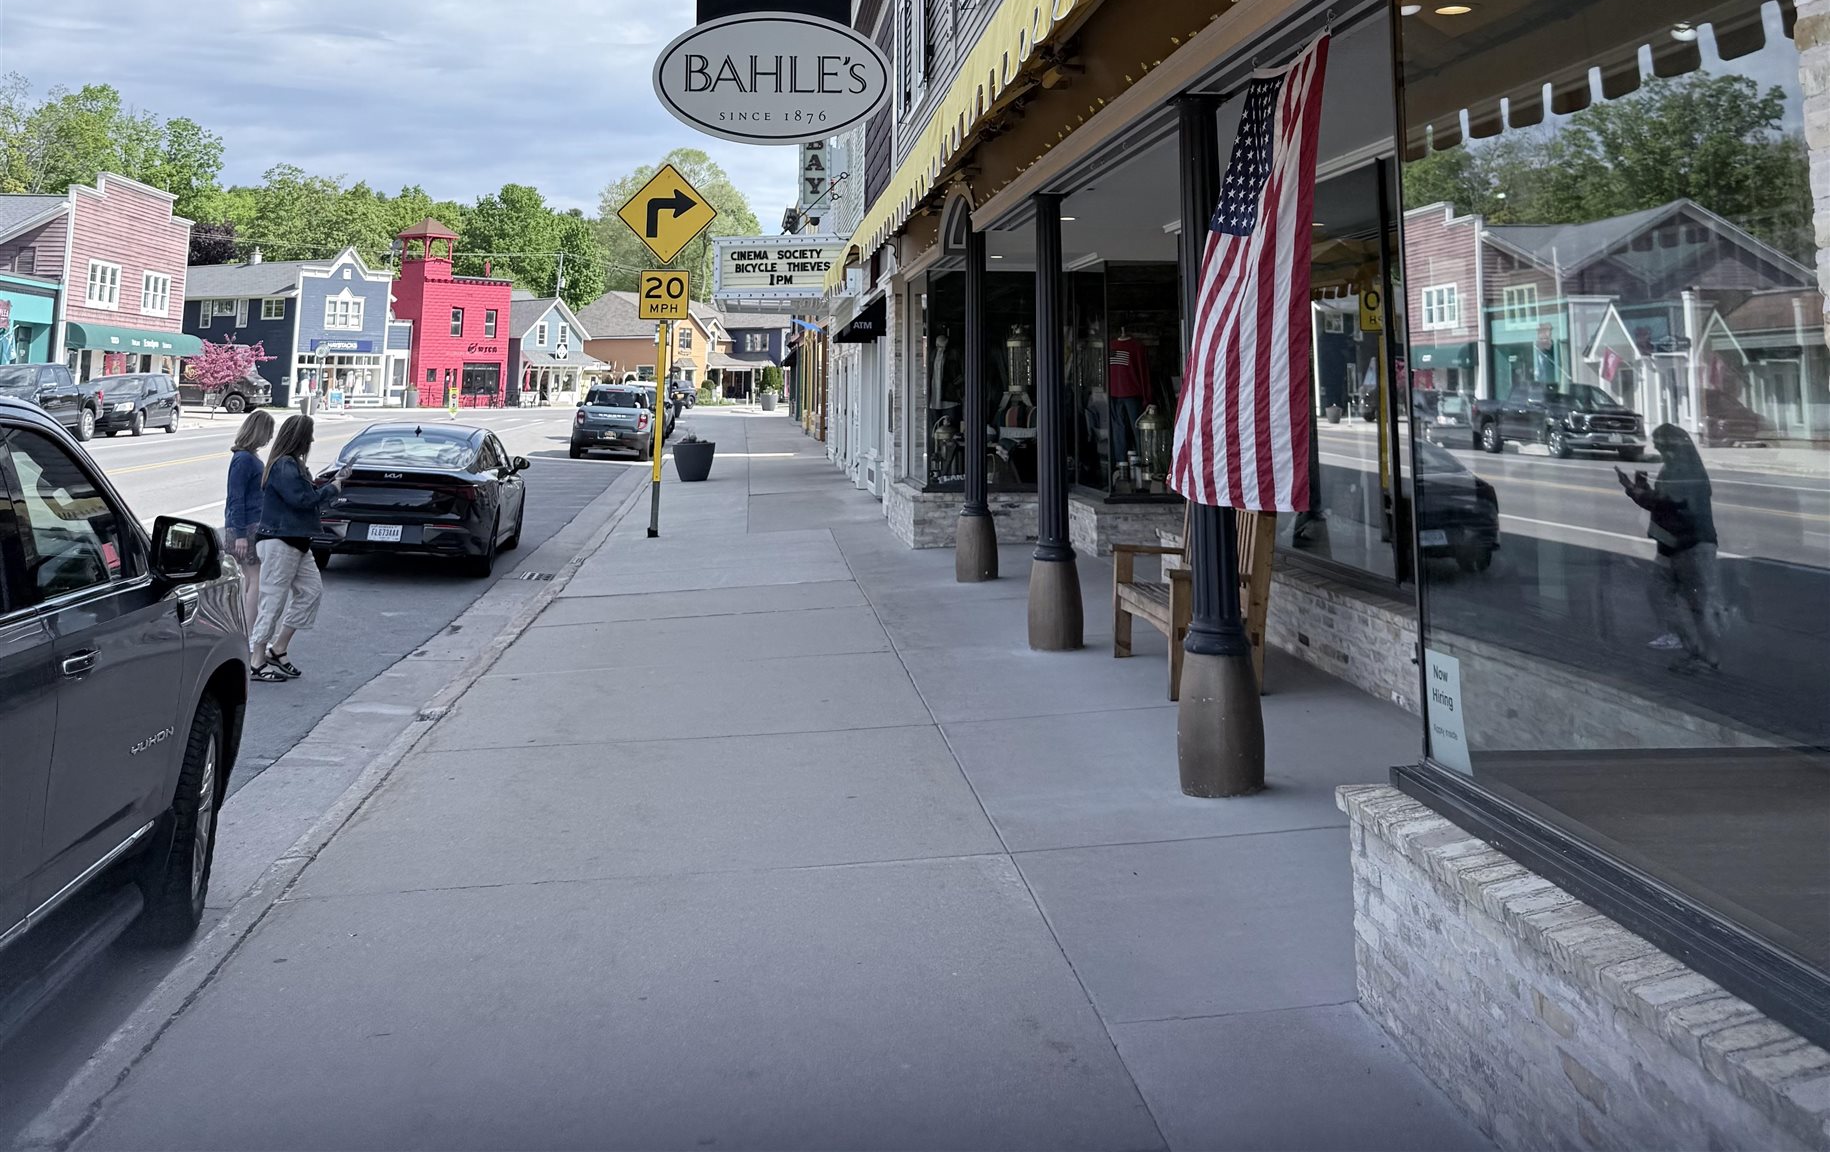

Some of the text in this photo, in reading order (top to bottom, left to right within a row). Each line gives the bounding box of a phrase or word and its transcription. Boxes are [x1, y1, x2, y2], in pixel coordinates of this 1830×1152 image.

[684, 54, 867, 94] BAHLE'S
[719, 110, 827, 124] SINCE 1876
[730, 249, 822, 261] CINEMA SOCIETY
[735, 261, 831, 273] BICYCLE THIEVES
[645, 277, 684, 299] 20
[650, 303, 678, 313] MPH
[853, 321, 873, 329] ATM
[1432, 664, 1448, 682] Now
[1432, 687, 1454, 712] Hiring
[131, 725, 174, 755] YUKON
